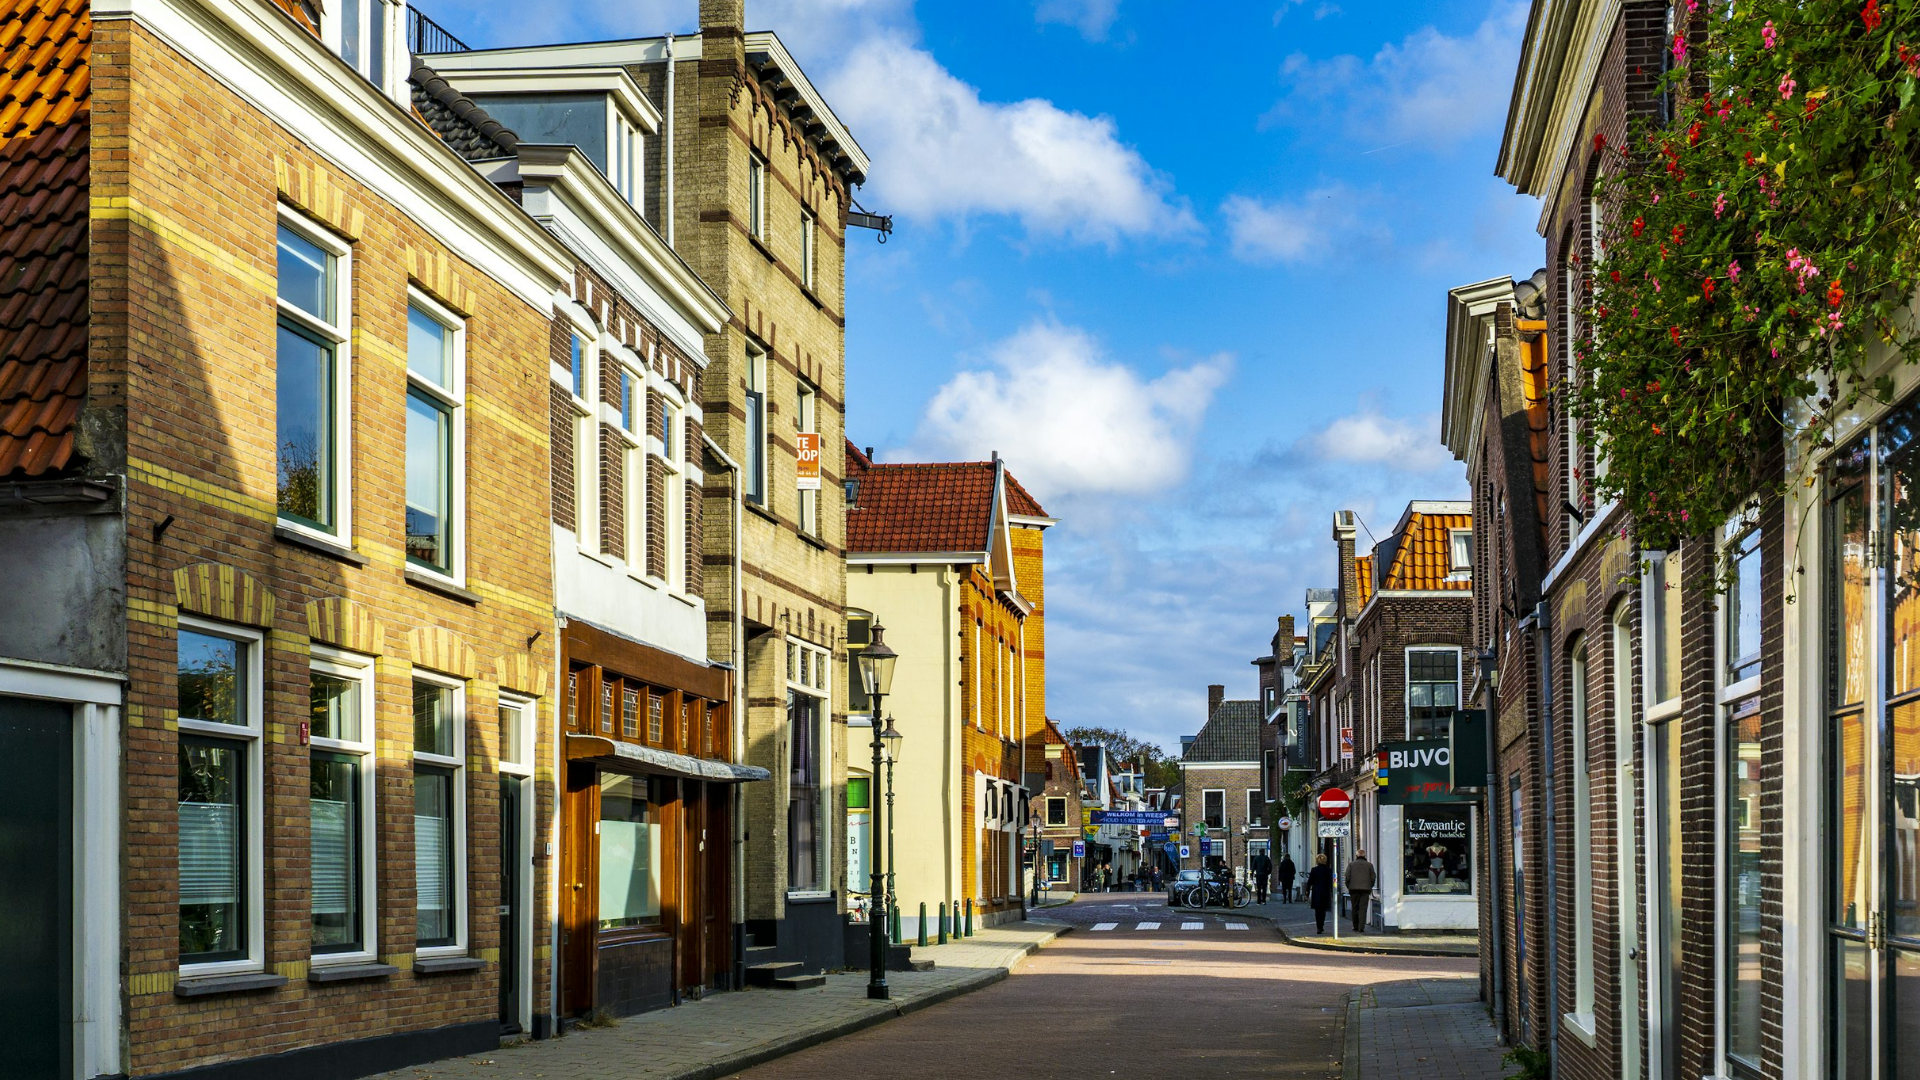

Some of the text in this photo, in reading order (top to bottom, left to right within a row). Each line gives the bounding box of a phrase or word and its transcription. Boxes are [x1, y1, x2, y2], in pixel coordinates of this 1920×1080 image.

[797, 437, 809, 448] TE
[797, 450, 818, 462] OOP
[1390, 748, 1450, 768] BIJVO
[1422, 782, 1444, 798] sport
[1419, 818, 1466, 834] Zwaantje
[1410, 832, 1429, 840] lingerie
